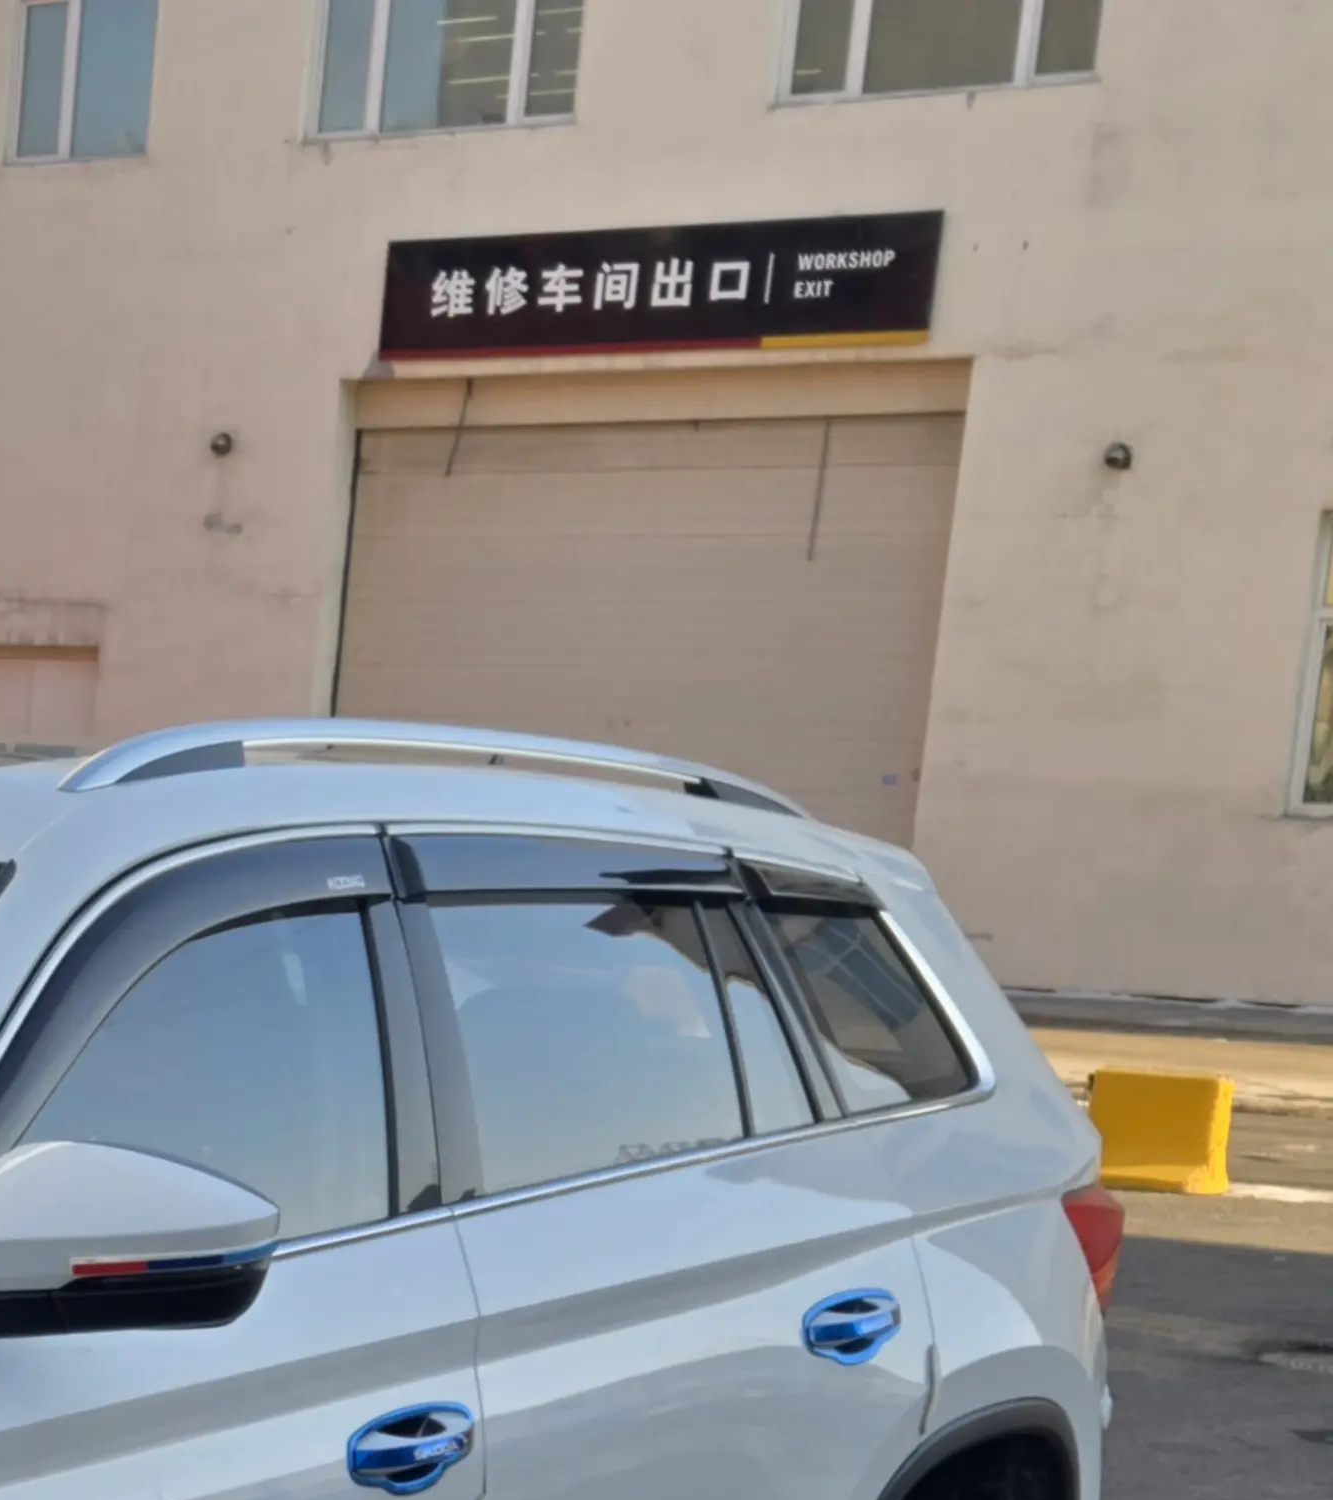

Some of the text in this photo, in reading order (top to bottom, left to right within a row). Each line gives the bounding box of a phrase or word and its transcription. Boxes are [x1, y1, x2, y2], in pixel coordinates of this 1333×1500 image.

[797, 250, 897, 271] WORKSHOP
[430, 257, 750, 317] 维修车间出口
[793, 279, 835, 299] EXIT
